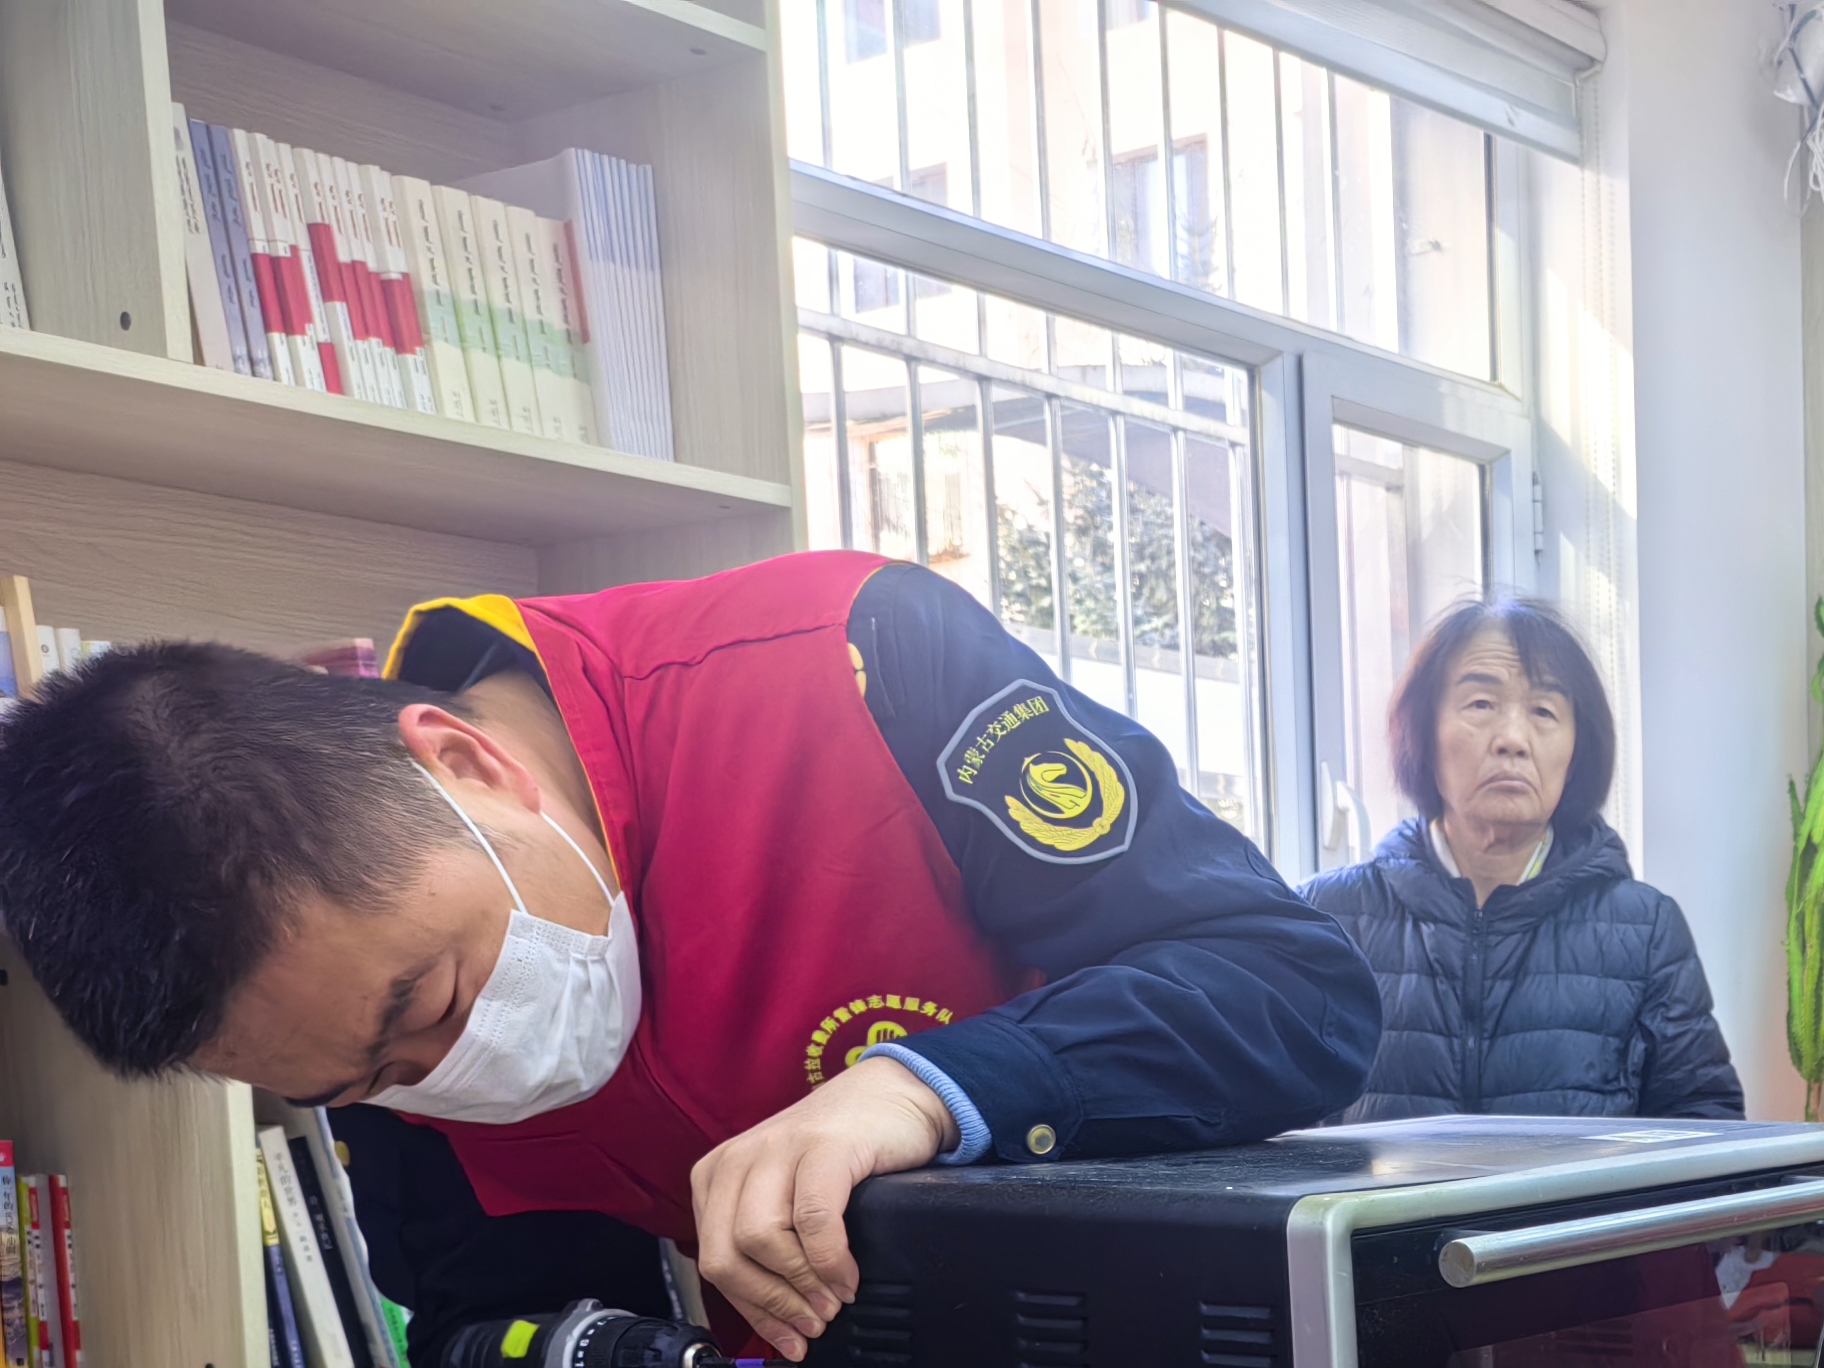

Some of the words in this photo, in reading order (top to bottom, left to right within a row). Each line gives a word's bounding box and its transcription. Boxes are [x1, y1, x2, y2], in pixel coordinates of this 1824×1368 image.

[957, 695, 1050, 785] 内蒙古交通集团
